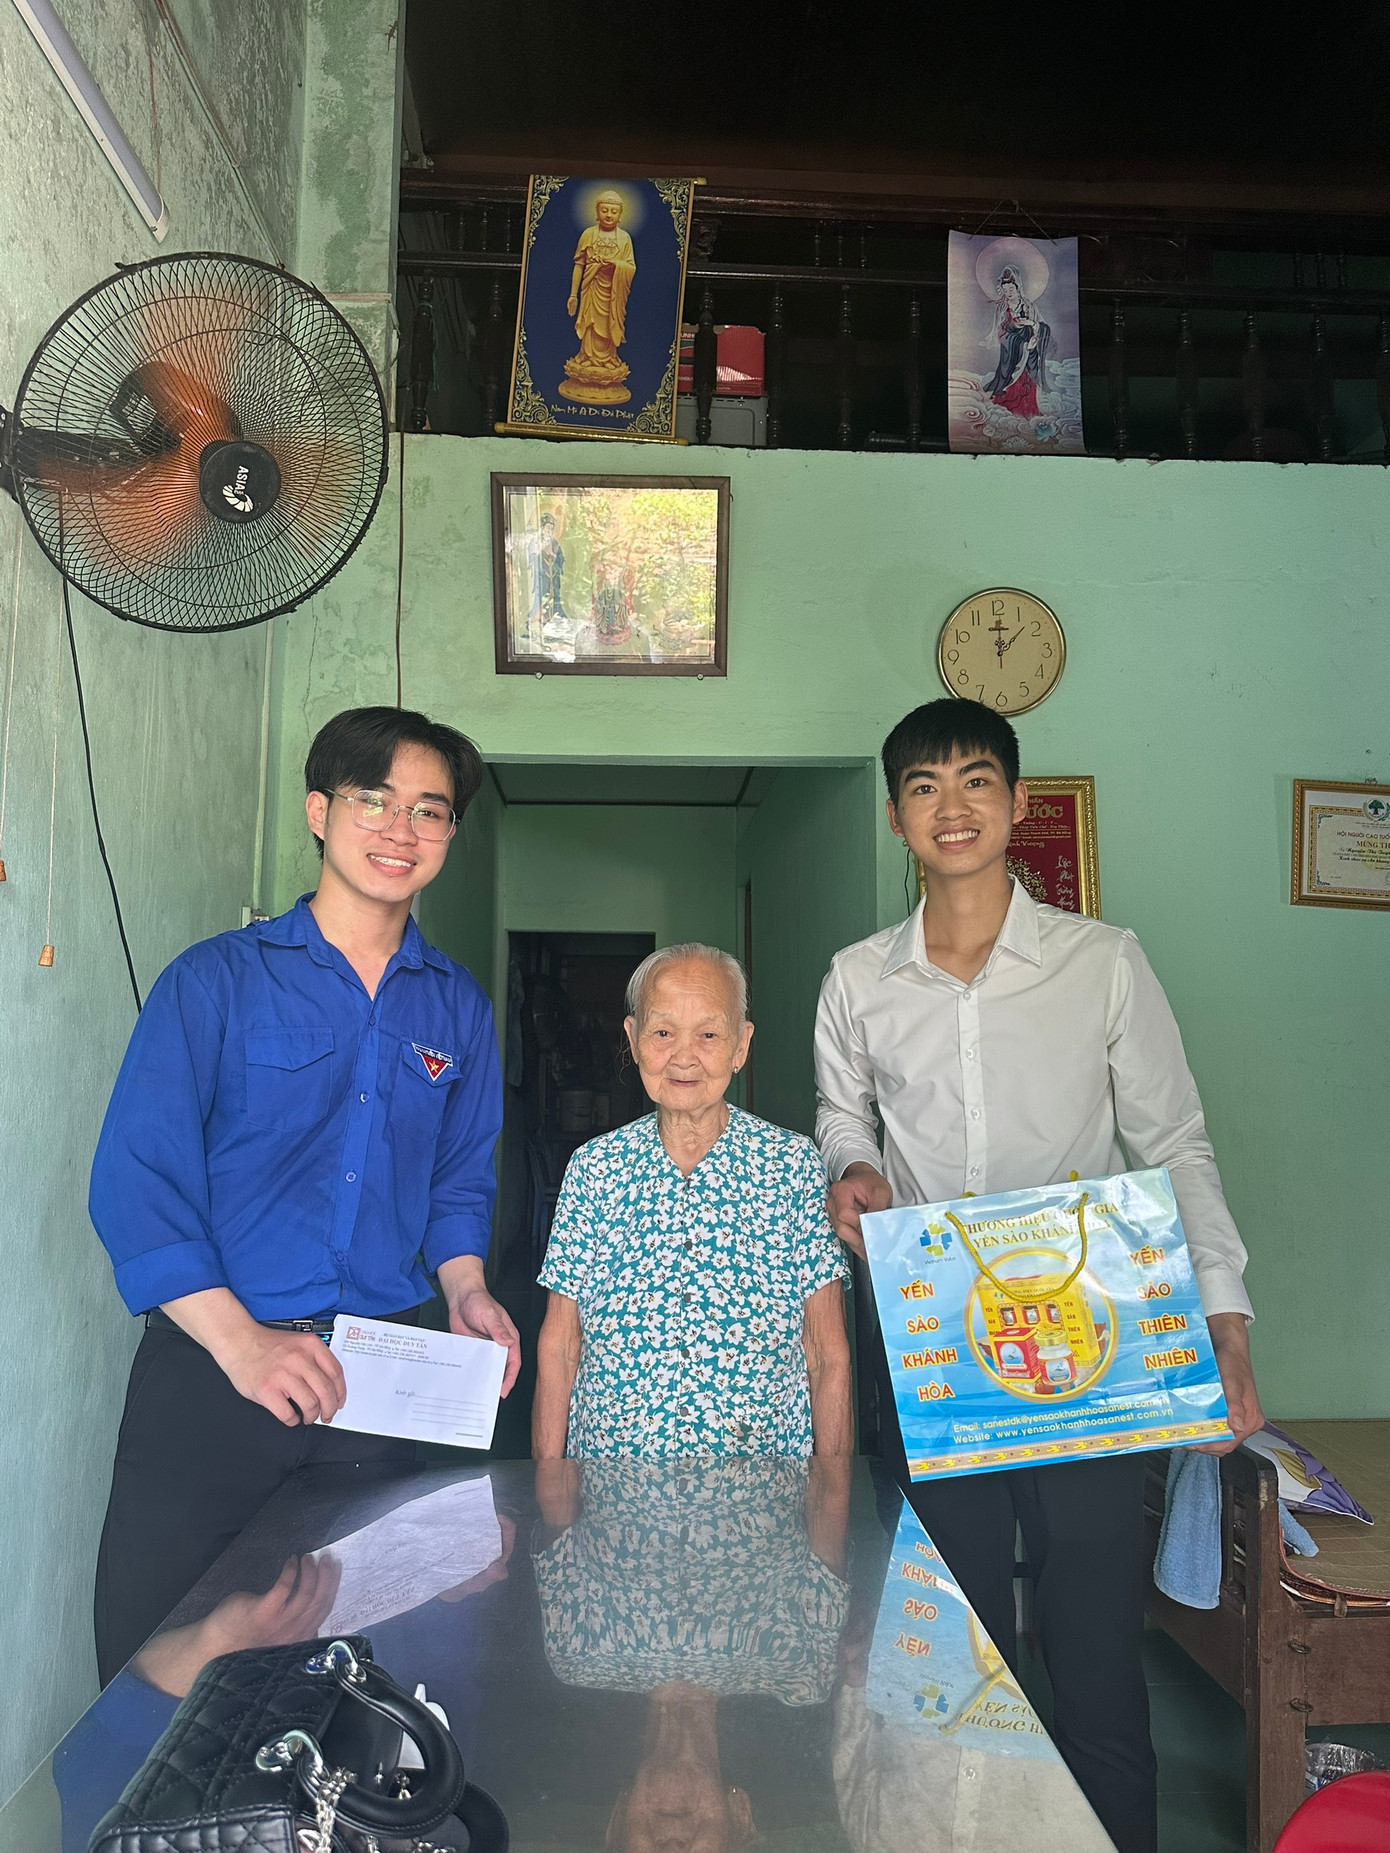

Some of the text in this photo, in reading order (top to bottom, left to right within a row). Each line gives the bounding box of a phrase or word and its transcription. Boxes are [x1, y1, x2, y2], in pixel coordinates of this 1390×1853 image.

[550, 404, 565, 413] Nam
[579, 406, 587, 416] A
[235, 465, 250, 490] ASIA
[992, 600, 1005, 616] 12
[1017, 606, 1021, 622] 1
[971, 610, 981, 626] 11
[956, 629, 971, 645] 10
[1030, 621, 1041, 637] 2
[947, 650, 959, 665] 9
[1042, 643, 1052, 659] 3
[957, 669, 969, 685] 8
[1034, 663, 1044, 679] 4
[975, 685, 985, 700] 7
[1019, 682, 1030, 698] 5
[995, 691, 1008, 707] 6
[1026, 804, 1064, 819] ƯỚC
[1095, 1203, 1118, 1214] GIA
[973, 1234, 1000, 1248] YẾN
[1002, 1231, 1028, 1244] SÀO
[1130, 1245, 1165, 1266] YẾN
[900, 1280, 934, 1300] YẾN
[1138, 1282, 1171, 1300] SÀO
[906, 1315, 939, 1333] SÀO
[1139, 1315, 1187, 1335] THIÊN
[902, 1348, 957, 1369] KHÁNH
[1144, 1349, 1197, 1370] NHIÊN
[918, 1382, 954, 1401] HÒA
[953, 1408, 1173, 1444] Website: www.yensaokhanhhoasanest.com.vn
[953, 1422, 981, 1433] Email:
